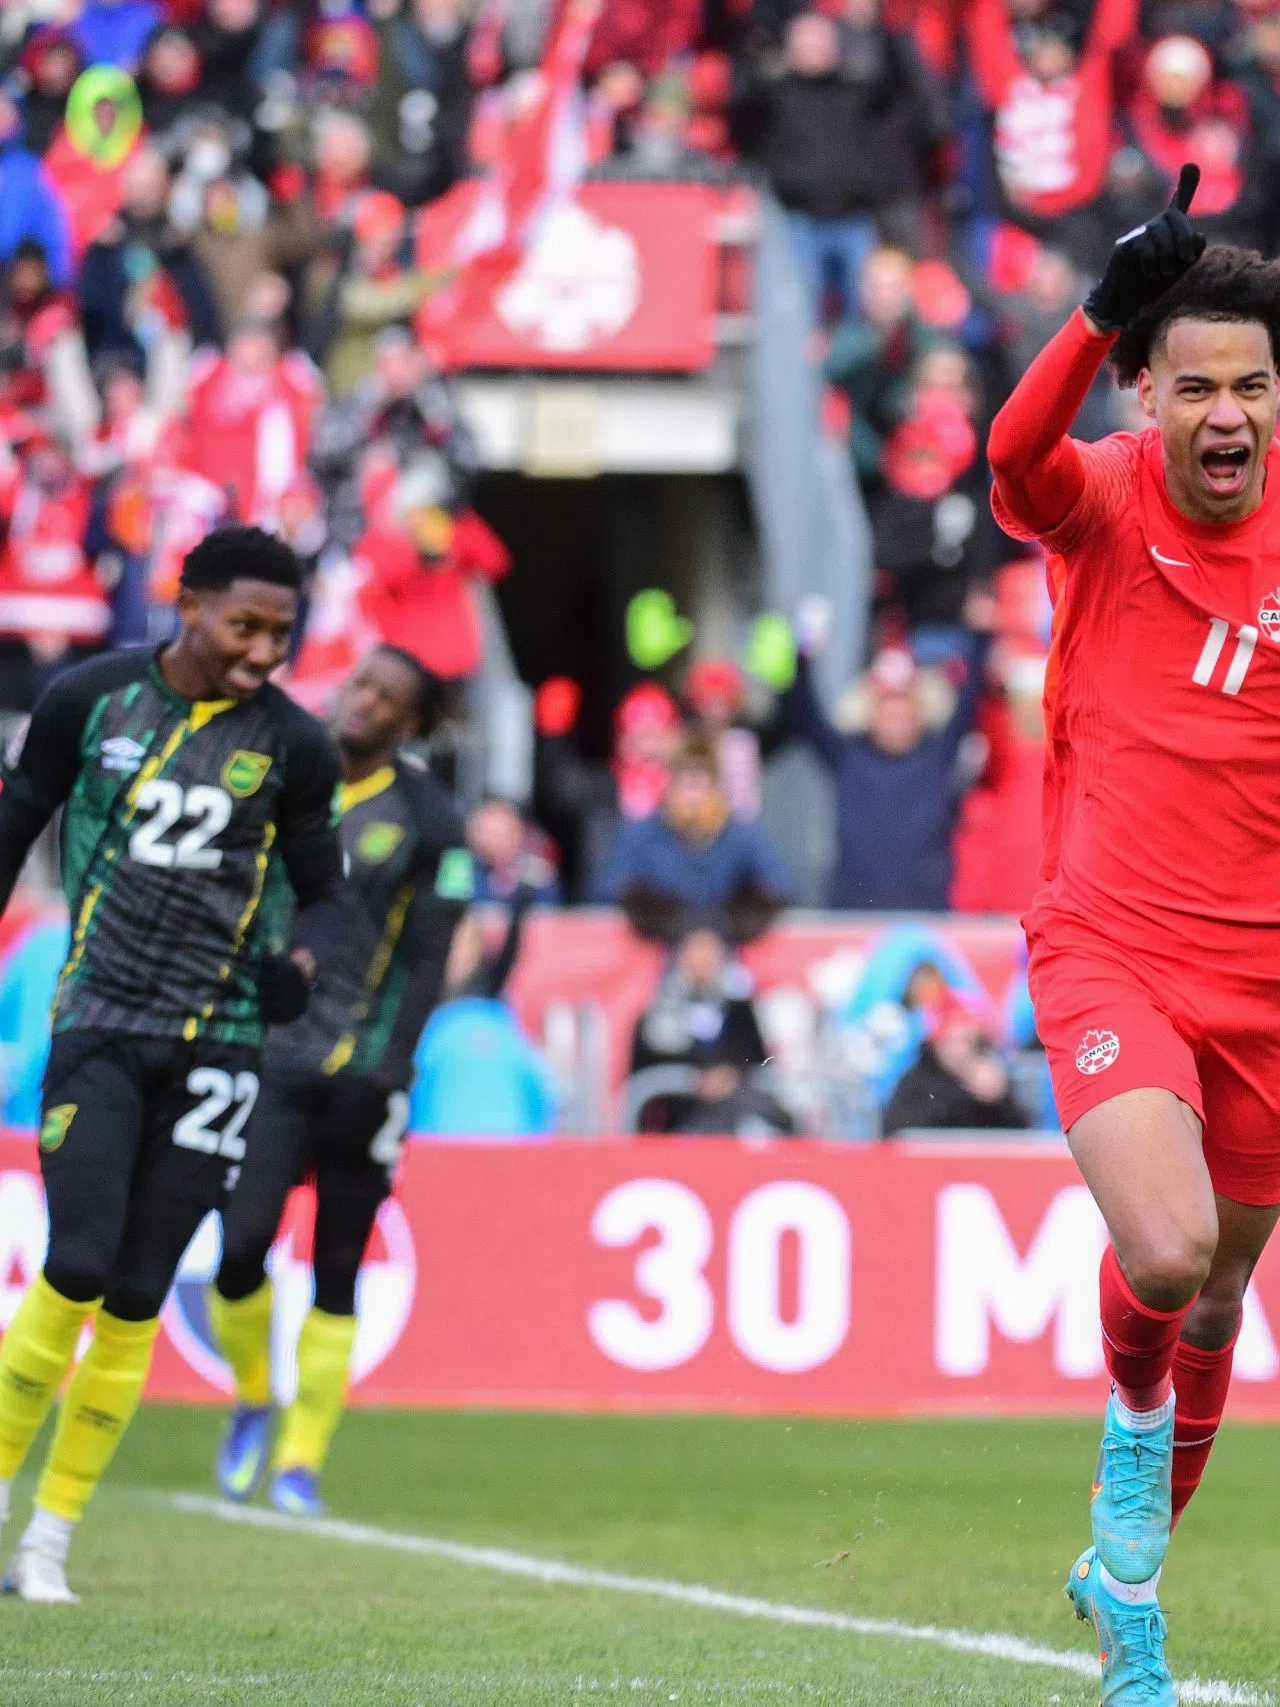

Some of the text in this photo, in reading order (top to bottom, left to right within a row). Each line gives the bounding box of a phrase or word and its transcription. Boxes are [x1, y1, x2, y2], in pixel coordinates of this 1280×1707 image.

[1192, 617, 1259, 696] 11
[129, 779, 233, 869] 22
[1077, 1041, 1117, 1066] CANADA
[172, 1067, 260, 1161] 22
[587, 1177, 852, 1374] 30
